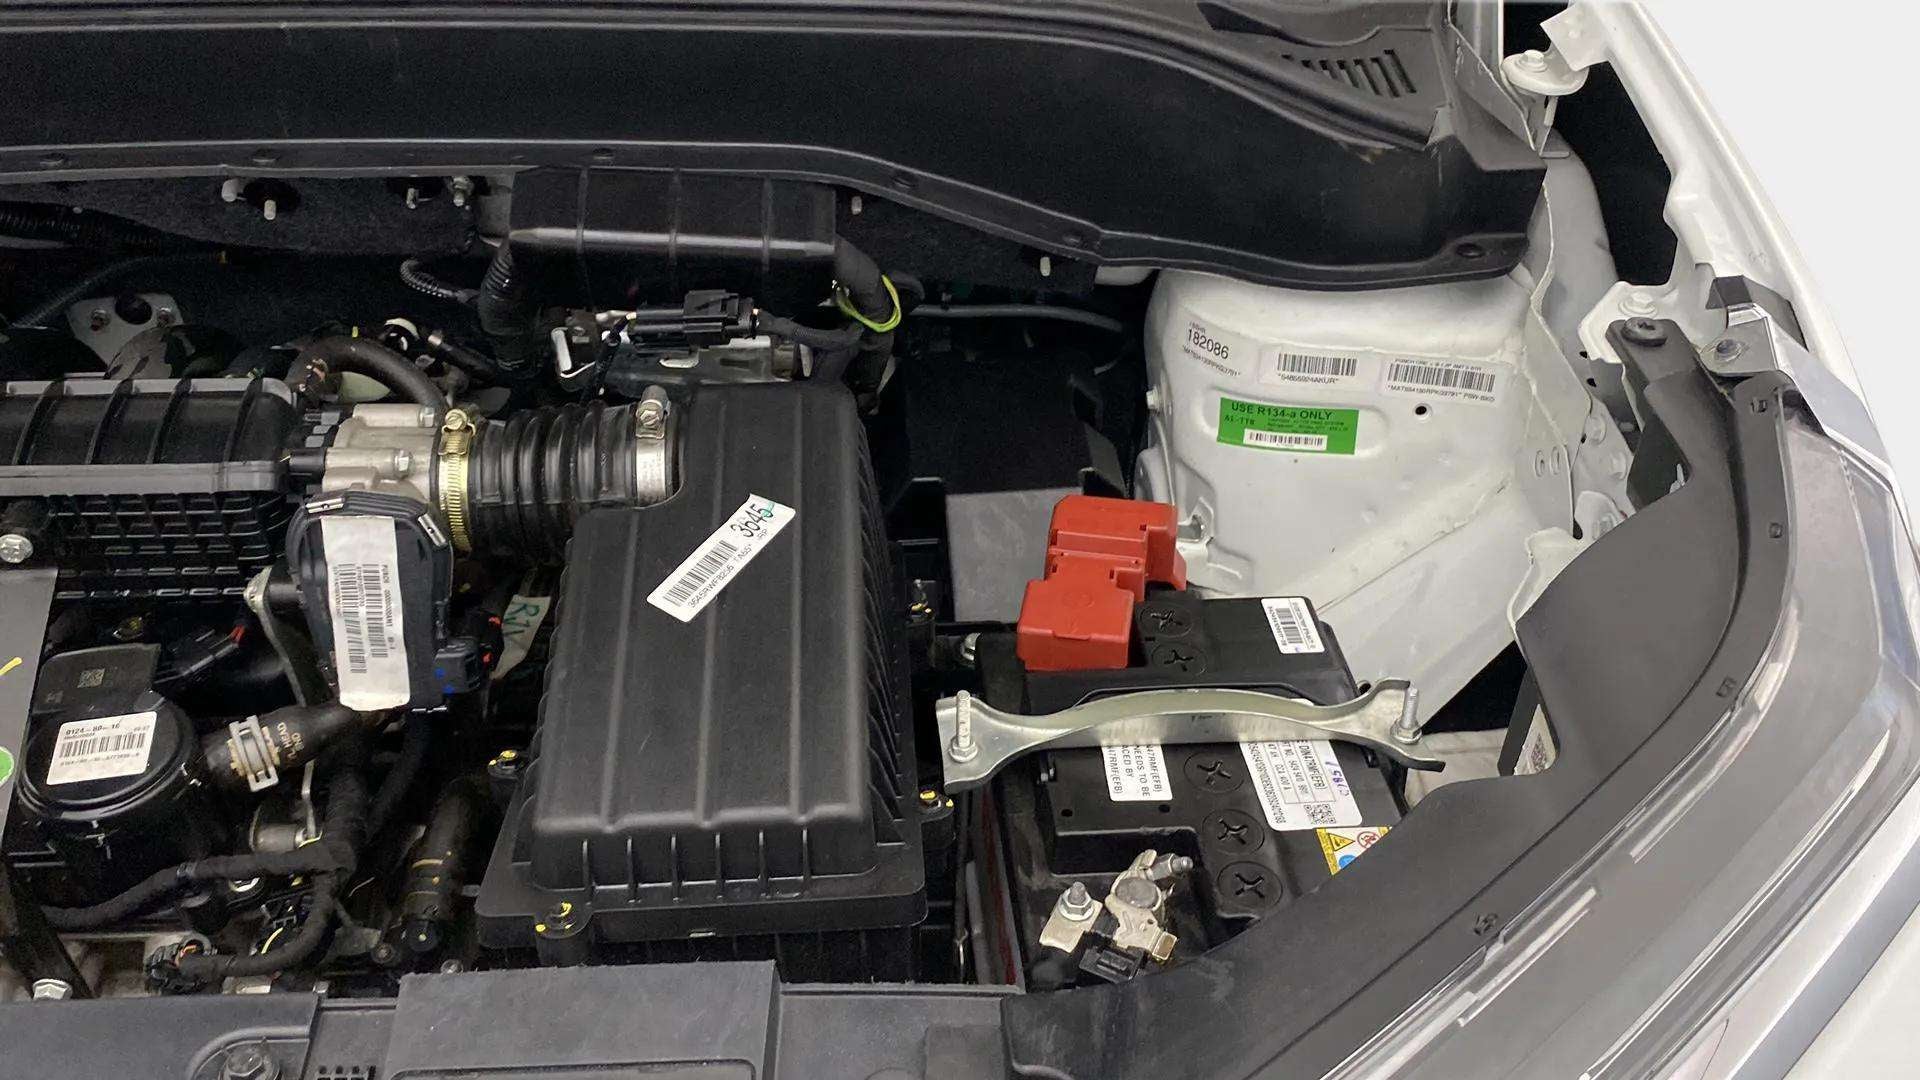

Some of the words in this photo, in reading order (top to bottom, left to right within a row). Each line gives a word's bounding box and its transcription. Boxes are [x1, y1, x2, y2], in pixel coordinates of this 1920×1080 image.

[1189, 329, 1229, 359] 182086
[1231, 401, 1253, 414] USE
[1257, 407, 1296, 419] R134-a
[1300, 410, 1333, 420] ONLY
[1121, 744, 1131, 765] ACED
[1125, 768, 1134, 778] BY
[1139, 774, 1147, 784] TO
[1141, 786, 1150, 797] BE
